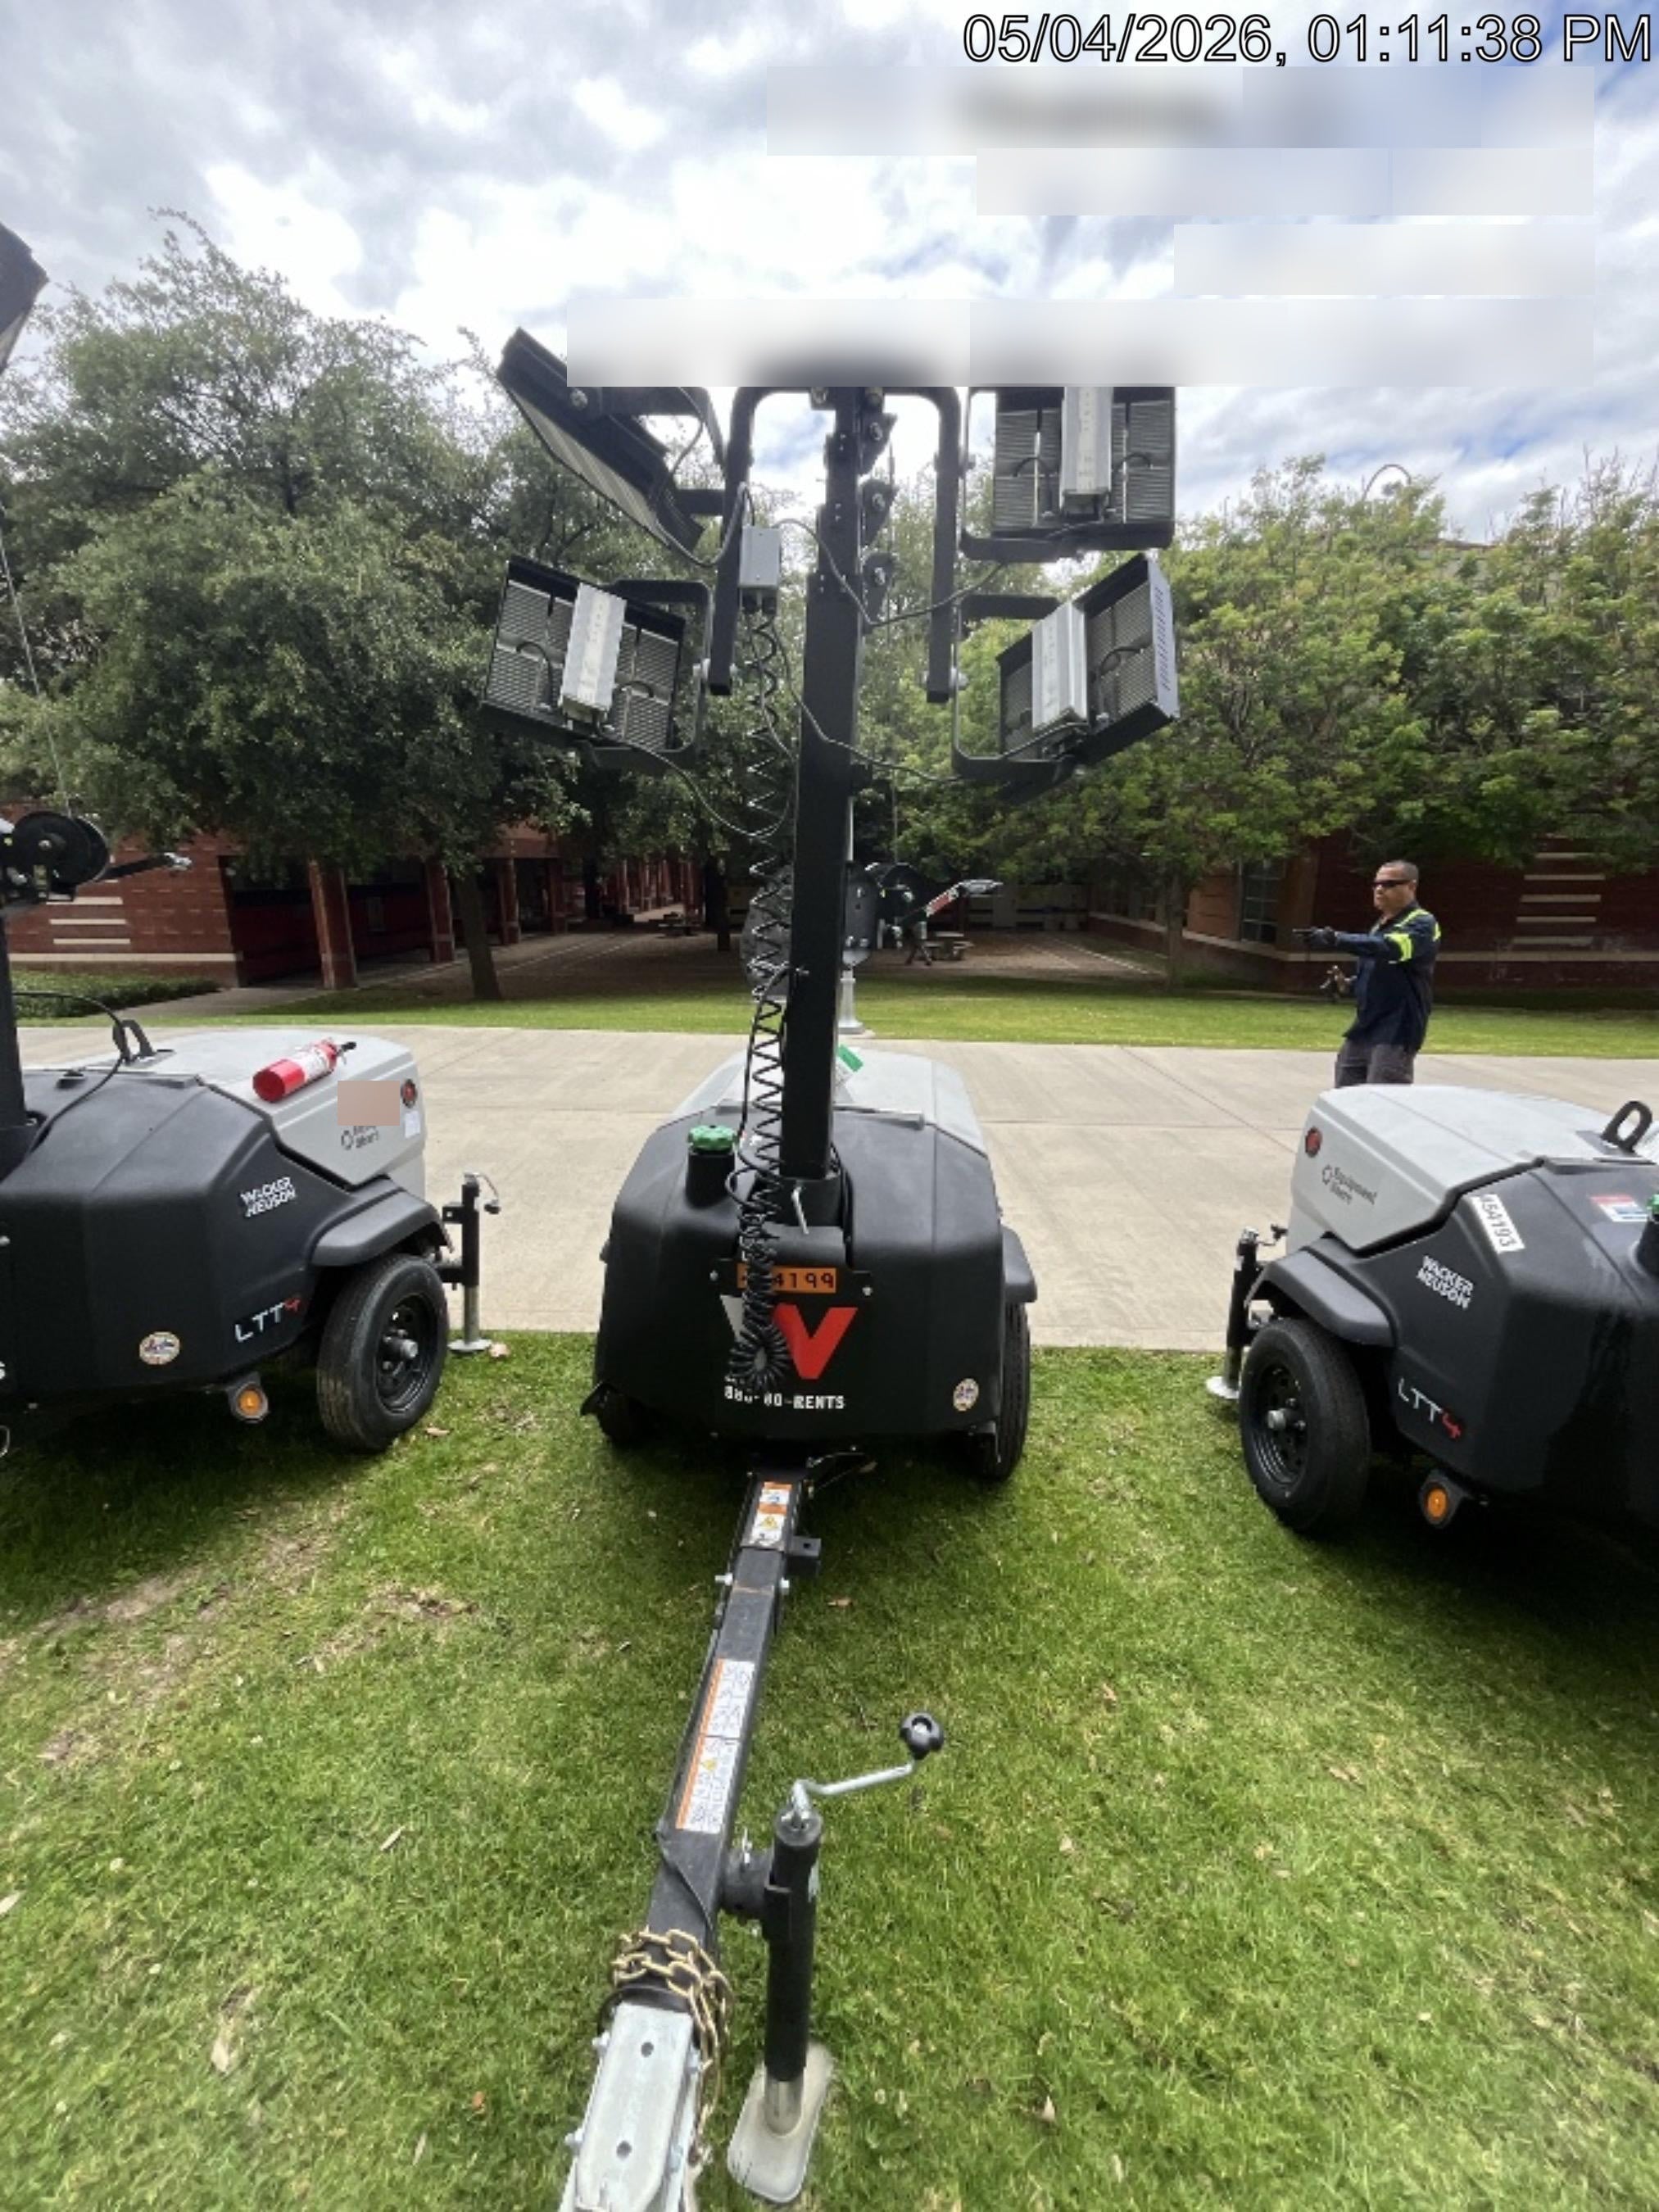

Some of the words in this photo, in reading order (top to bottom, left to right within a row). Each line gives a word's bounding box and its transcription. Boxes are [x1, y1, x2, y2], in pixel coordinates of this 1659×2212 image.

[741, 1271, 834, 1289] 4199
[1415, 1267, 1471, 1308] NEUSON
[1422, 1254, 1474, 1296] WACKER
[1398, 1377, 1462, 1439] LTT4
